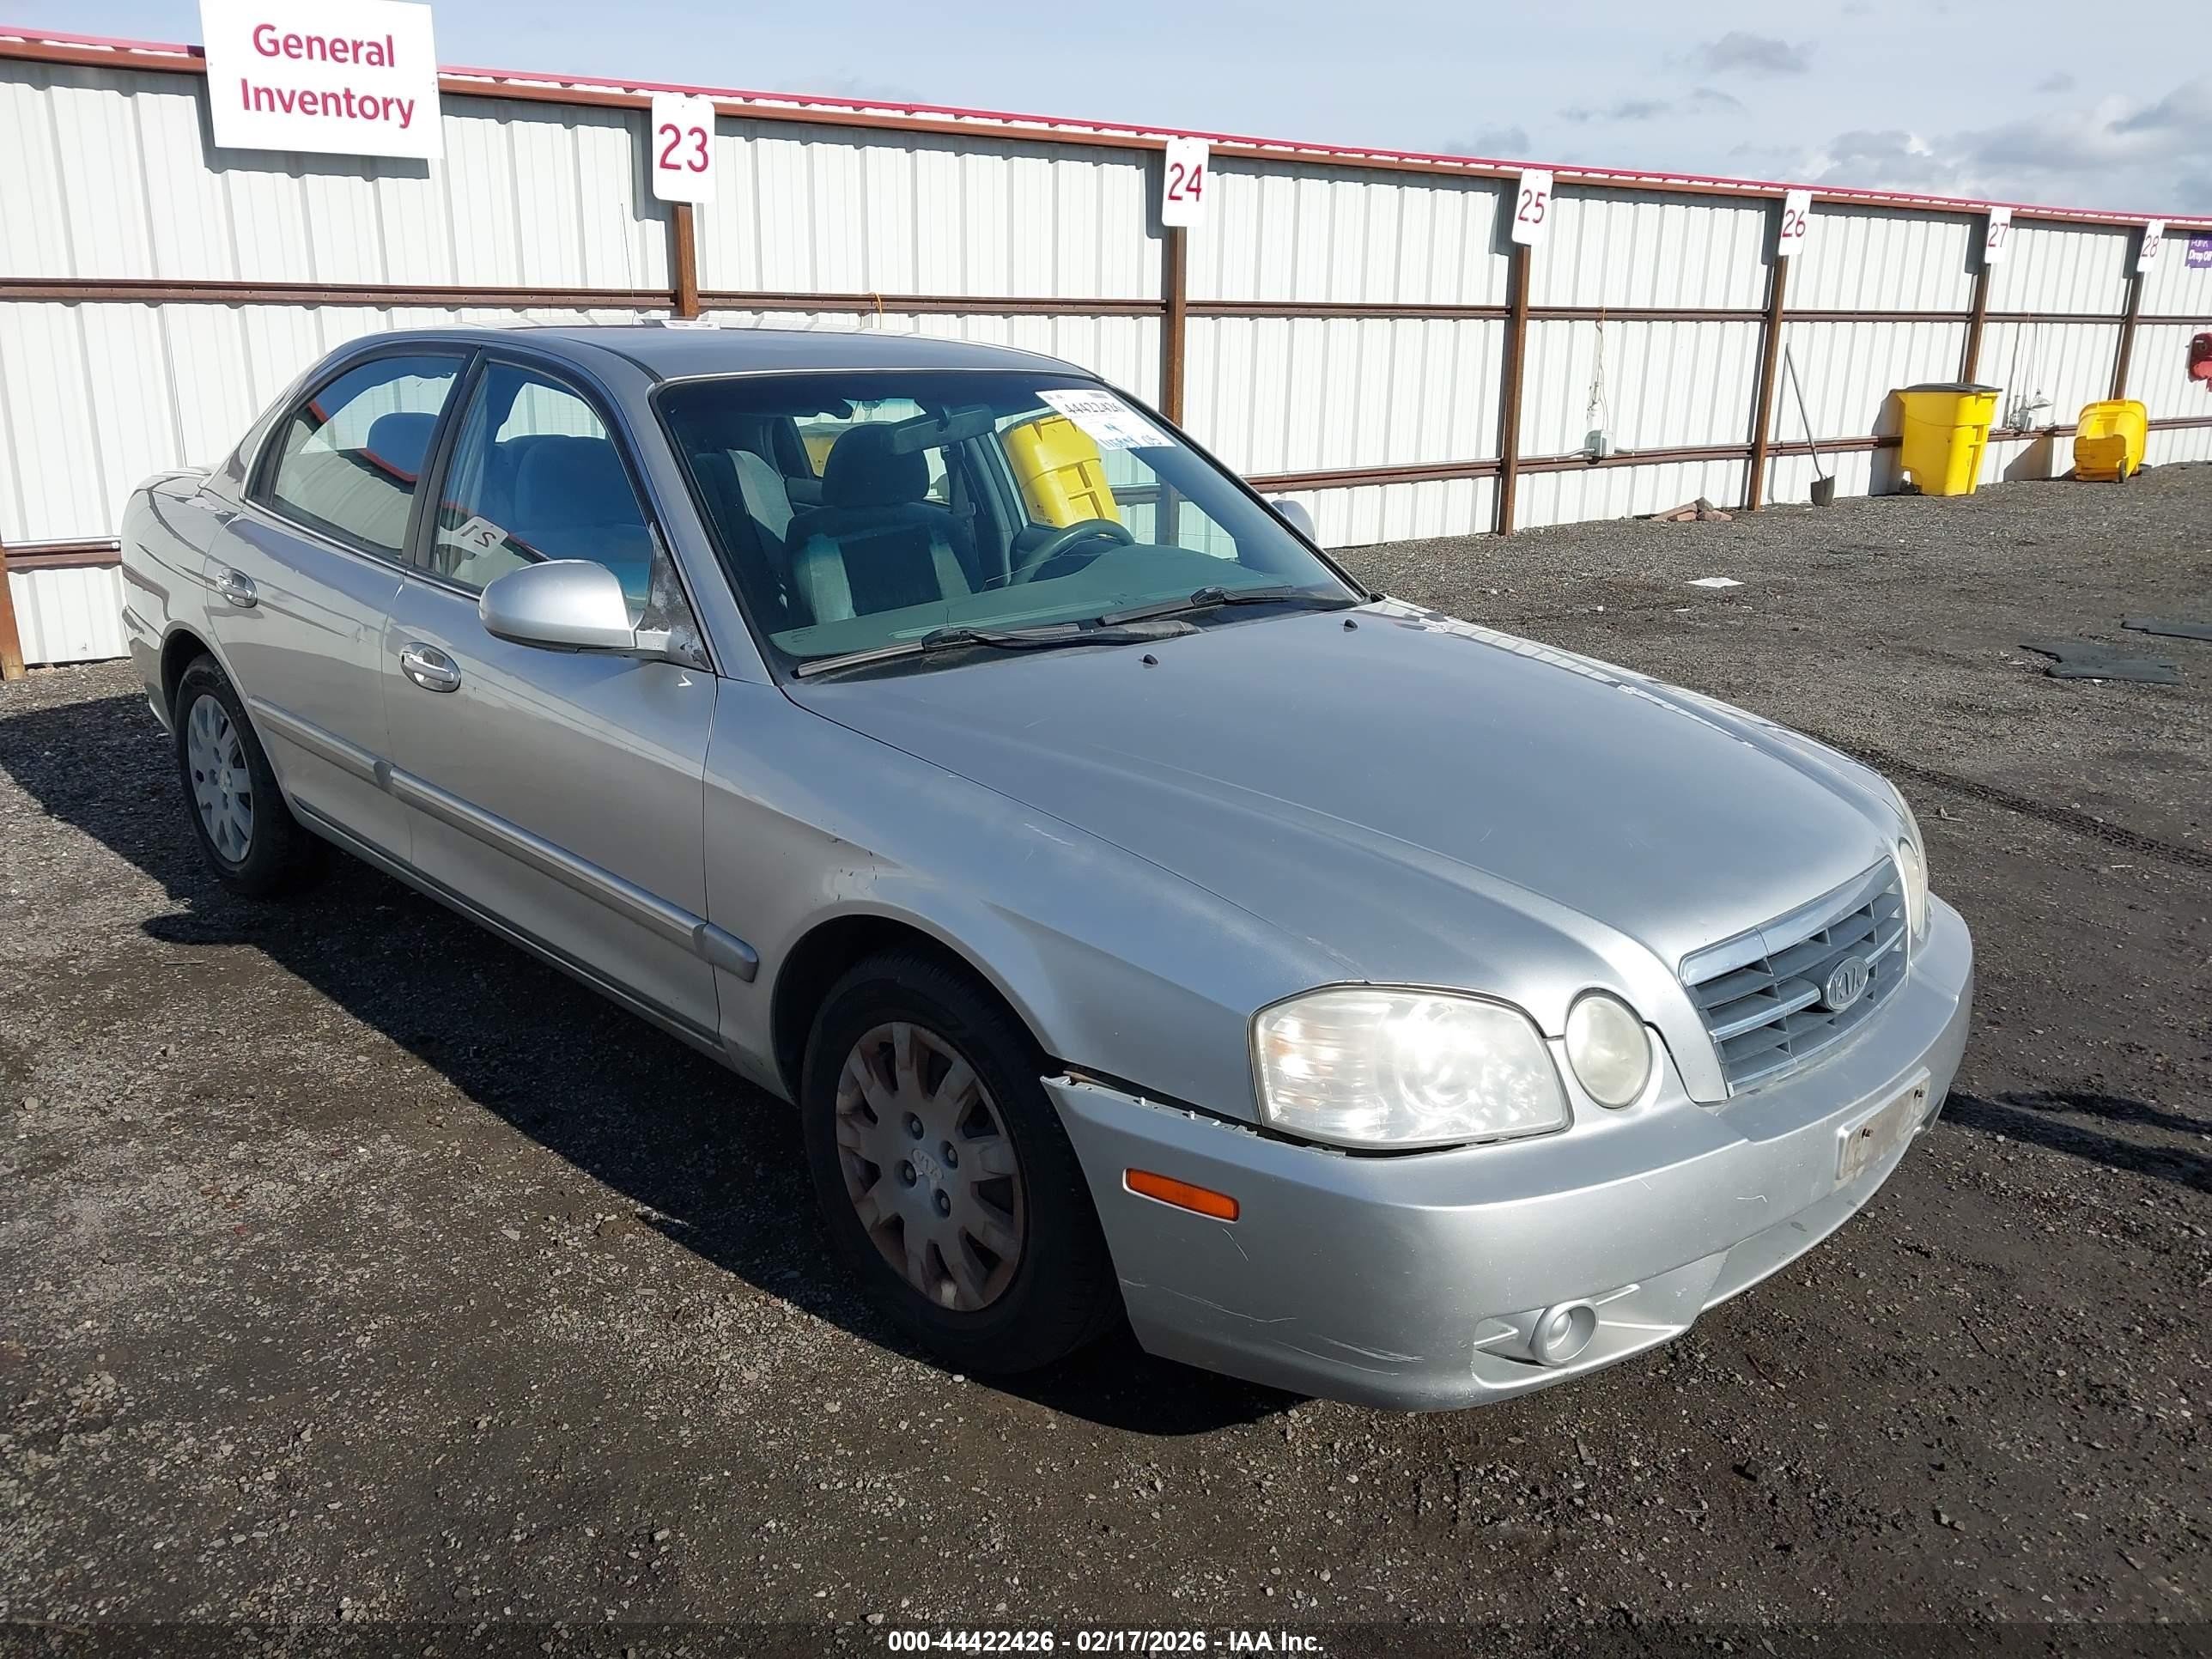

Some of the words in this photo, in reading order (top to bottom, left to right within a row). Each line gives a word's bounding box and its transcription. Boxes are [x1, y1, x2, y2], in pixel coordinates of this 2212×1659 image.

[252, 23, 395, 68] General
[240, 78, 415, 129] Inventory
[658, 123, 709, 173] 23
[1168, 162, 1202, 202] 24
[1518, 189, 1547, 224] 25
[1782, 209, 1806, 238] 26
[1987, 222, 2009, 248] 27
[2141, 234, 2160, 258] 28
[1065, 402, 1126, 414] 44422426
[1833, 968, 1861, 1003] KIA
